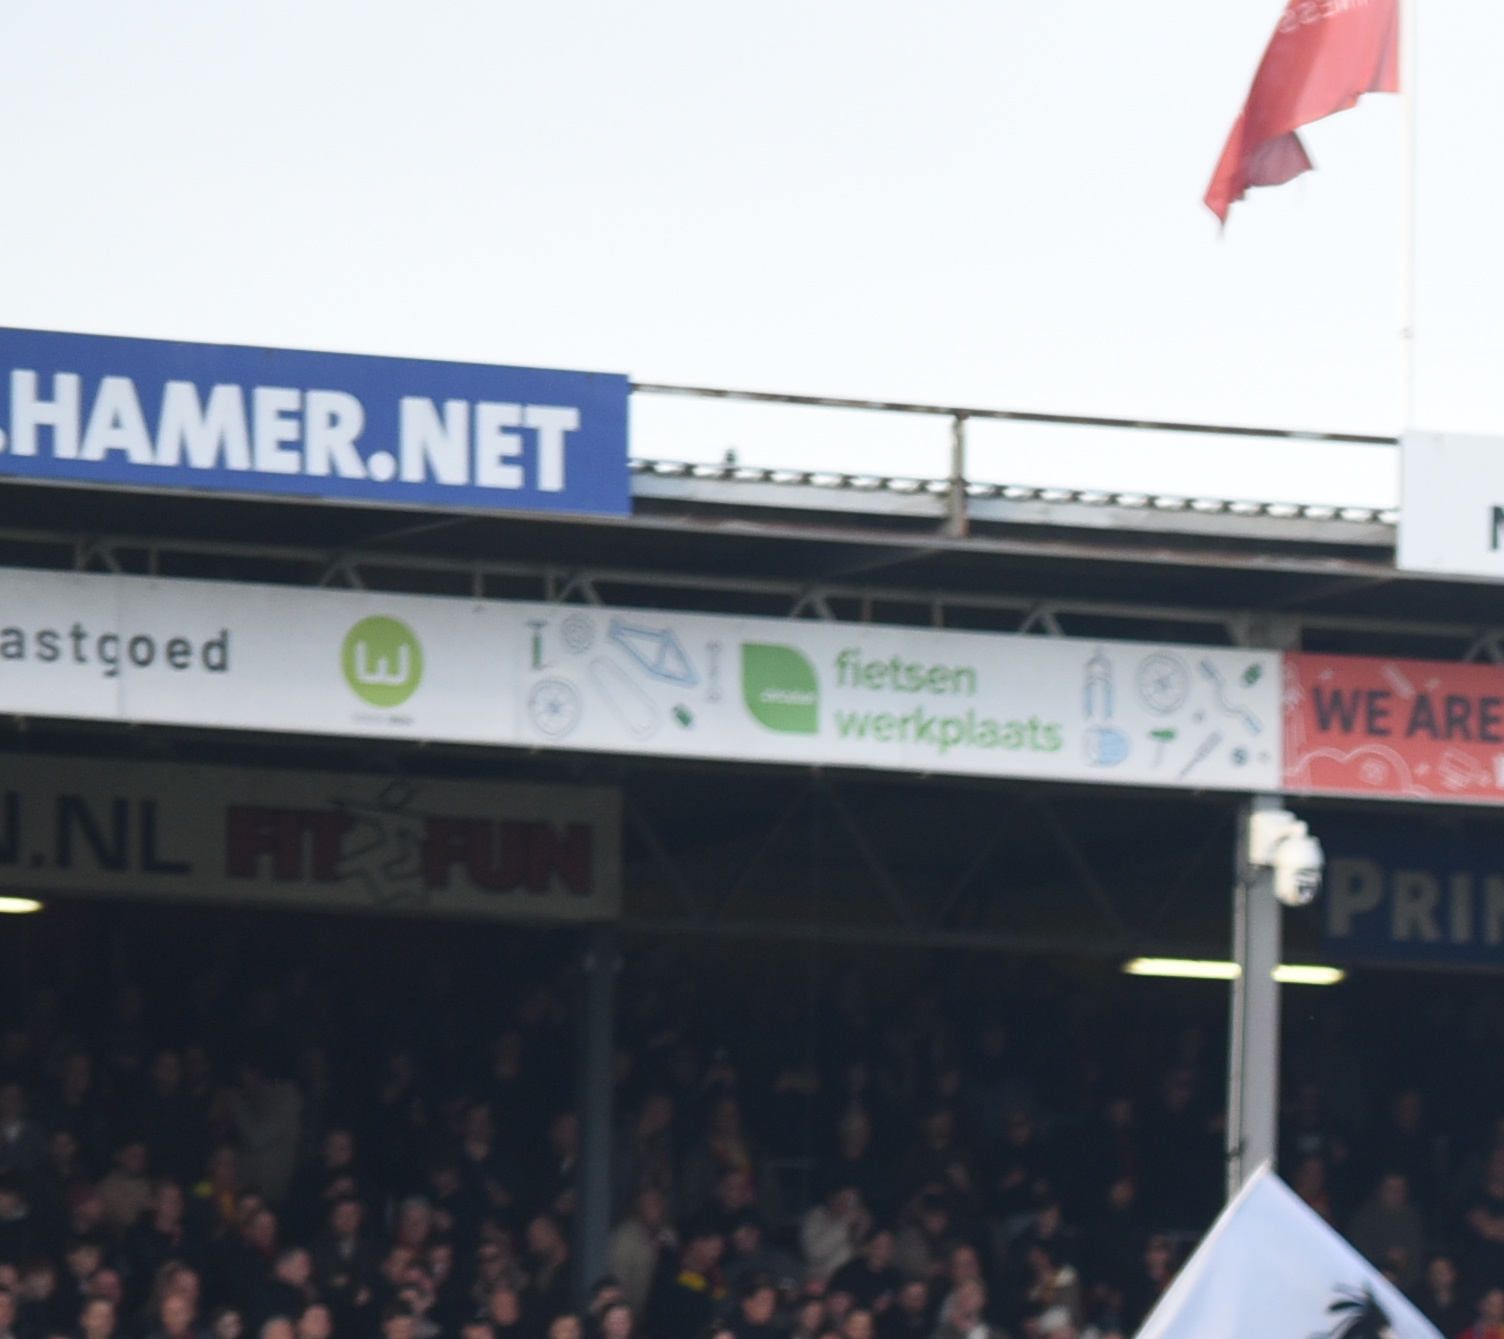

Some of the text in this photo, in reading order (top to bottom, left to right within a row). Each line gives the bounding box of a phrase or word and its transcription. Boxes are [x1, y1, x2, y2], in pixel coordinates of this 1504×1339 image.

[0, 369, 581, 492] HAMER.NET
[836, 648, 978, 694] fietsen
[834, 705, 1063, 755] werkplaats
[1310, 686, 1391, 736] WE
